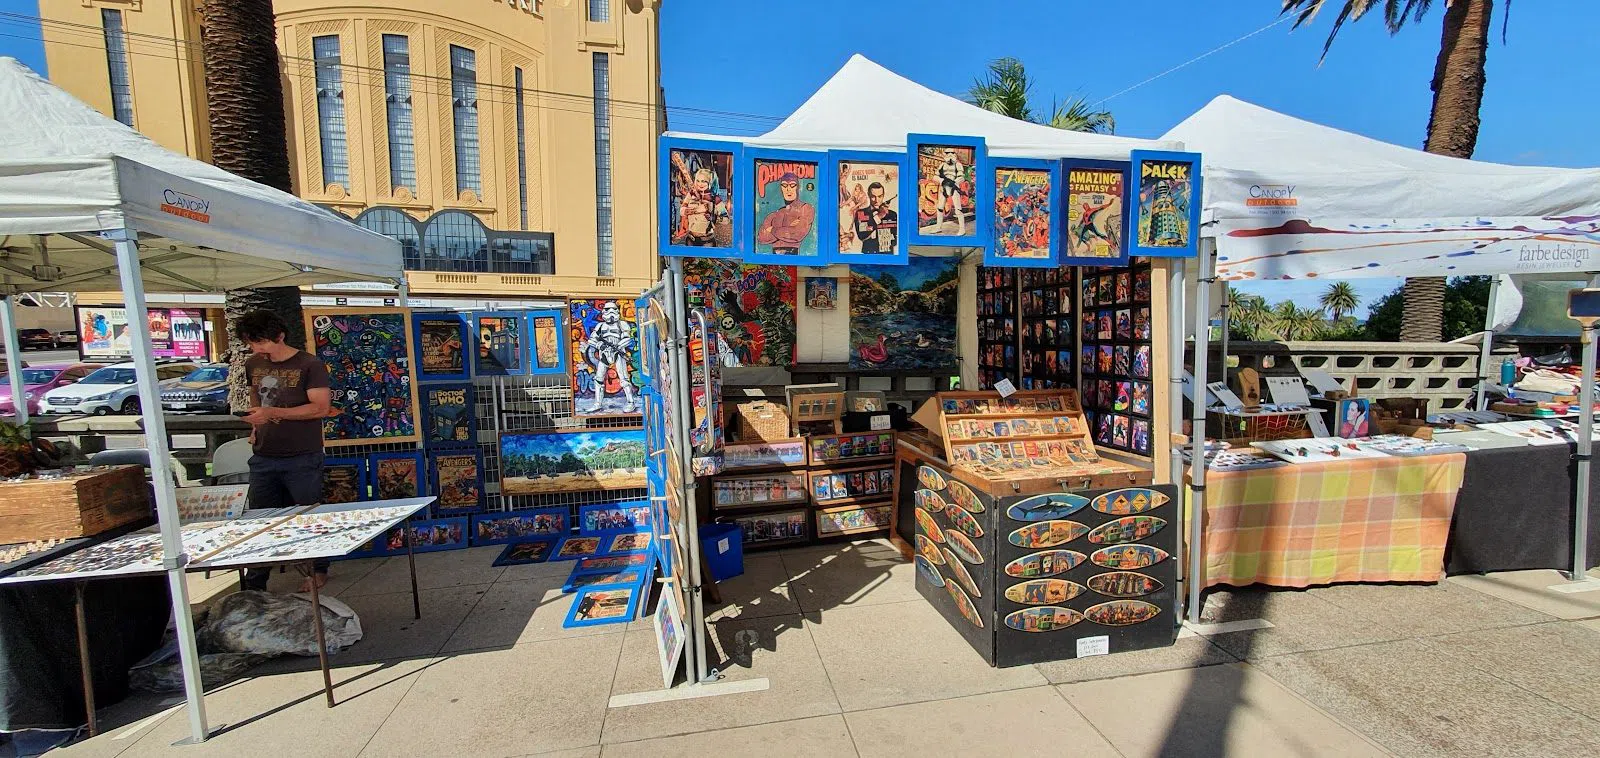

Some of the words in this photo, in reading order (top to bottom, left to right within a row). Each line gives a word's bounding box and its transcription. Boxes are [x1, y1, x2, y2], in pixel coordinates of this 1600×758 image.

[1004, 169, 1048, 188] AVENGERS
[1069, 171, 1116, 185] AMAZING
[1142, 163, 1187, 180] DALEK
[758, 162, 815, 198] PHANTOM
[1075, 183, 1110, 192] FANTASY
[1249, 184, 1296, 198] CANOPY
[163, 189, 209, 213] CANOPY
[1519, 243, 1551, 261] farbe
[1552, 243, 1589, 268] design
[438, 395, 465, 405] WHO
[443, 458, 473, 467] AVENGERS
